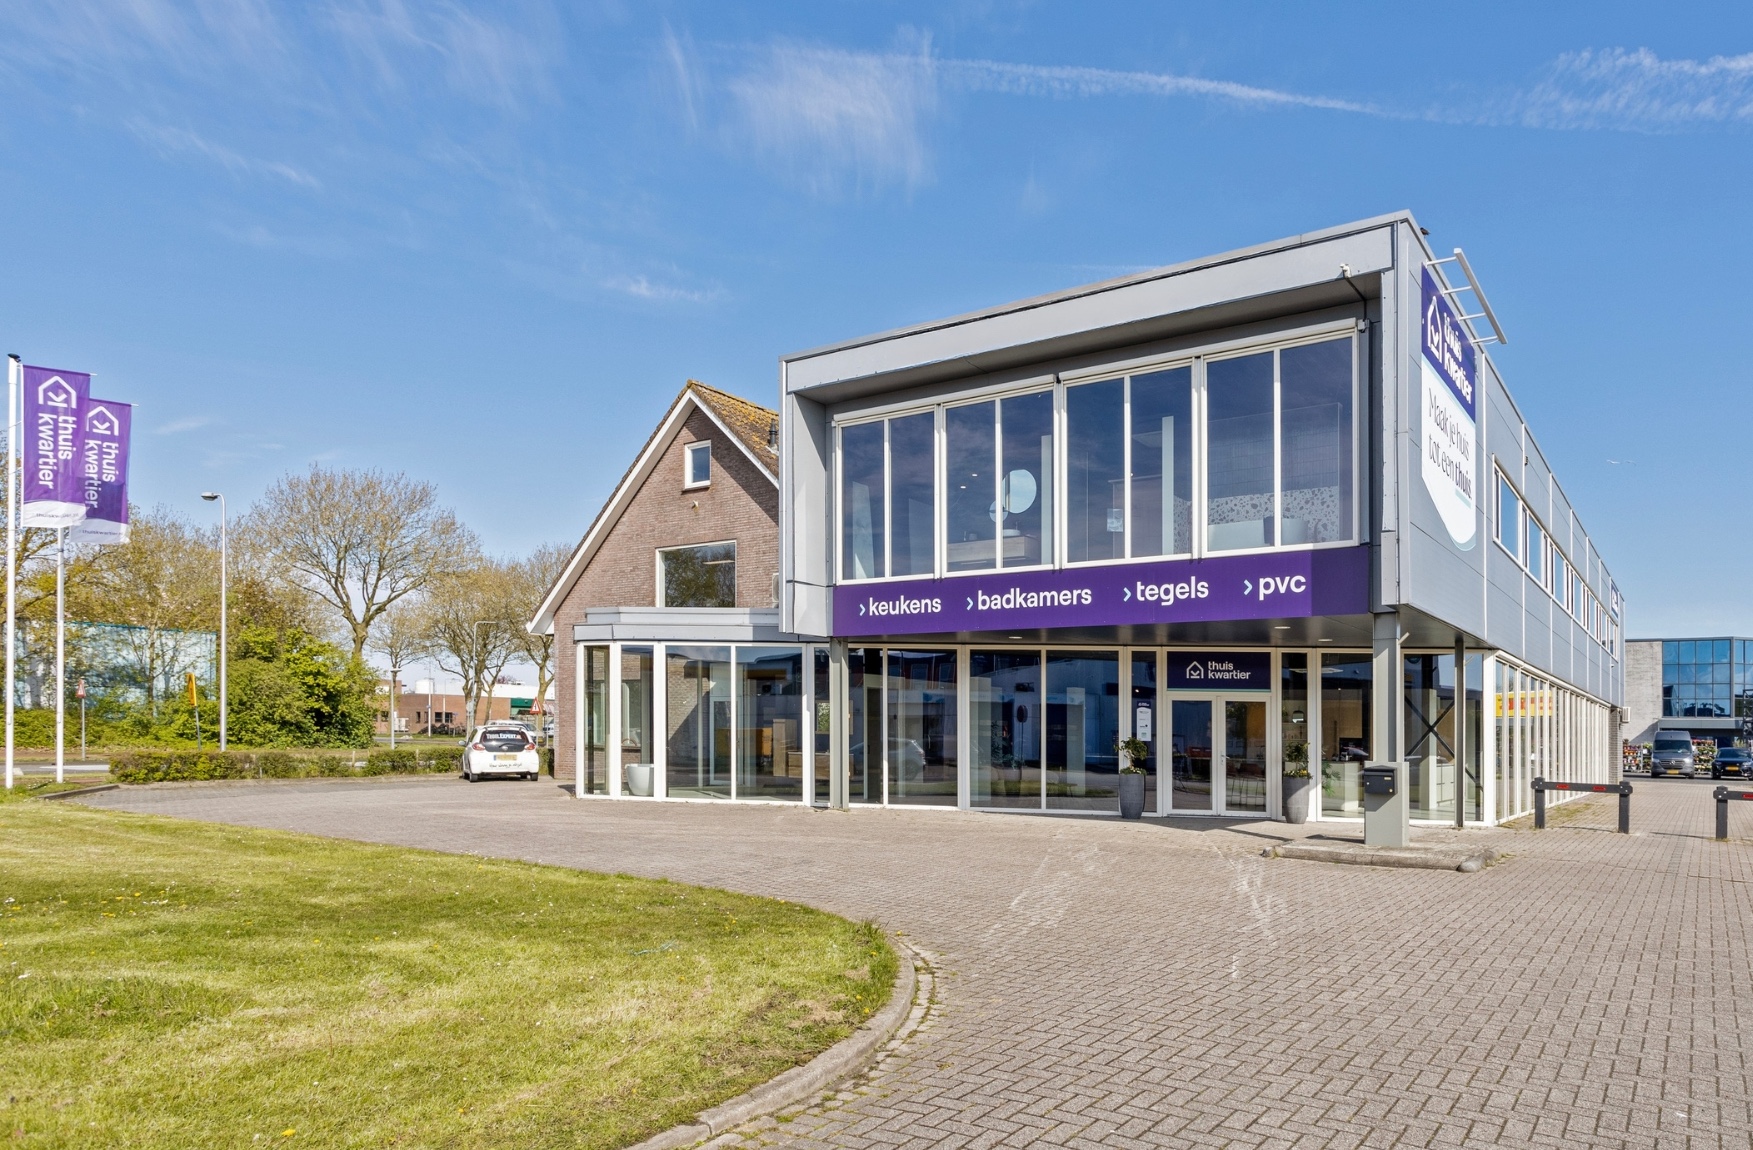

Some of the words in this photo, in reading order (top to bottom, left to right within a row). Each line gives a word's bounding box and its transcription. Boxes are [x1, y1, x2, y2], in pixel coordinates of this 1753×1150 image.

[58, 415, 77, 460] thuis
[1429, 387, 1449, 438] Maak
[1449, 414, 1456, 448] je
[1456, 422, 1469, 461] huis
[38, 412, 58, 490] kwartier
[84, 439, 102, 508] kwartier
[102, 441, 119, 483] thuis
[1428, 433, 1440, 468] tot
[1441, 451, 1454, 481] een
[868, 595, 942, 616] keukens
[977, 587, 1092, 611] badkamers
[1136, 575, 1209, 606] tegels
[1258, 575, 1307, 601] pvc
[1207, 661, 1234, 670] thuis
[1207, 670, 1251, 679] kwartier
